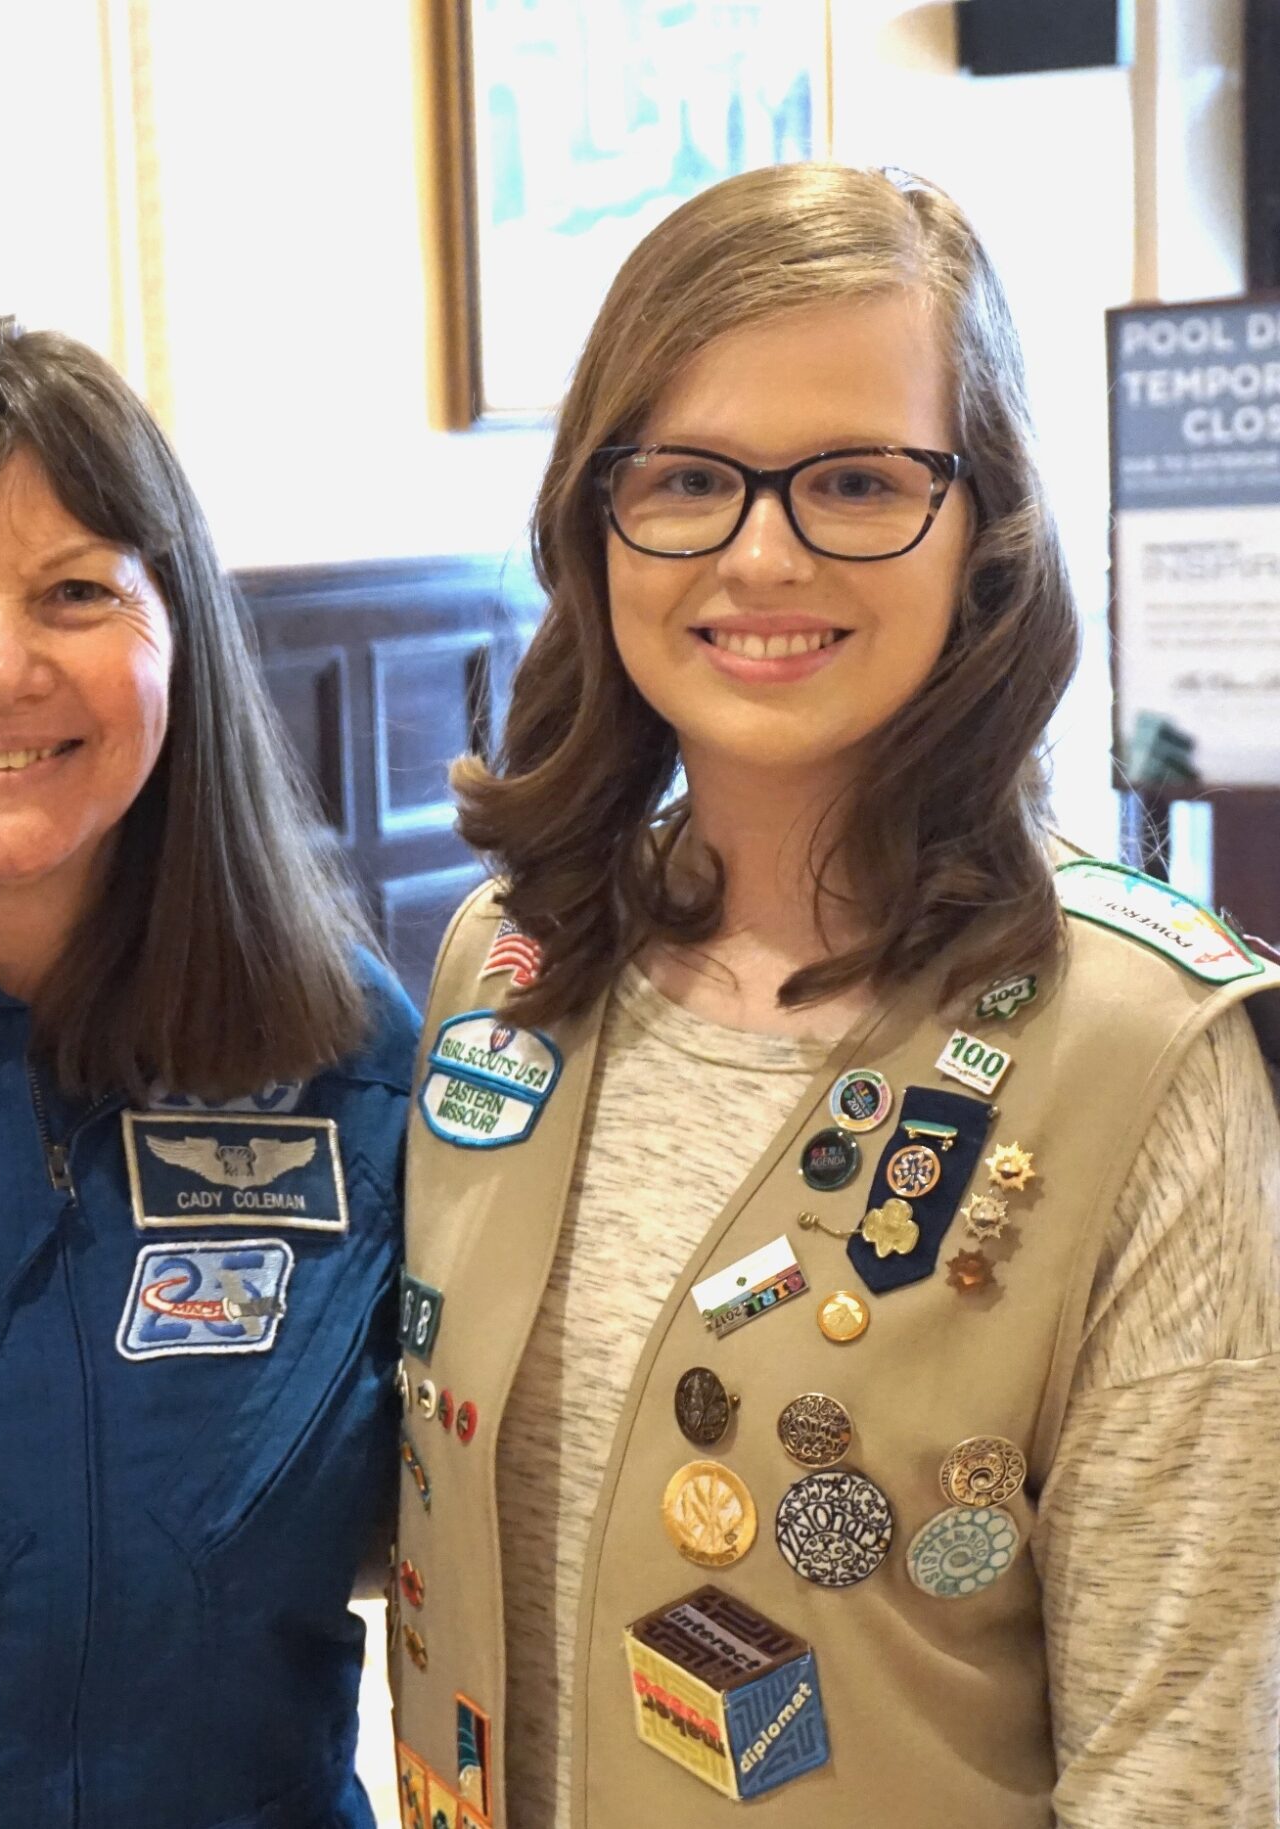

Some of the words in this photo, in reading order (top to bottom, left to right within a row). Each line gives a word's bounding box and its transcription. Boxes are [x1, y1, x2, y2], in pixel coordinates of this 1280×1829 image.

[1121, 317, 1234, 359] POOL
[1246, 311, 1280, 351] D
[987, 984, 1023, 1003] 100
[440, 1037, 466, 1065] GIRL
[464, 1046, 519, 1077] SCOUTS
[515, 1062, 550, 1091] USA
[951, 1034, 1005, 1079] 100
[436, 1097, 501, 1135] MISSOURI
[444, 1077, 507, 1116] EASTERN
[846, 1096, 866, 1119] 2017
[810, 1153, 847, 1168] AGENDA
[177, 1190, 223, 1209] CADY
[233, 1190, 307, 1212] COLEMAN
[669, 1606, 762, 1670] interact
[738, 1681, 813, 1774] diplomat
